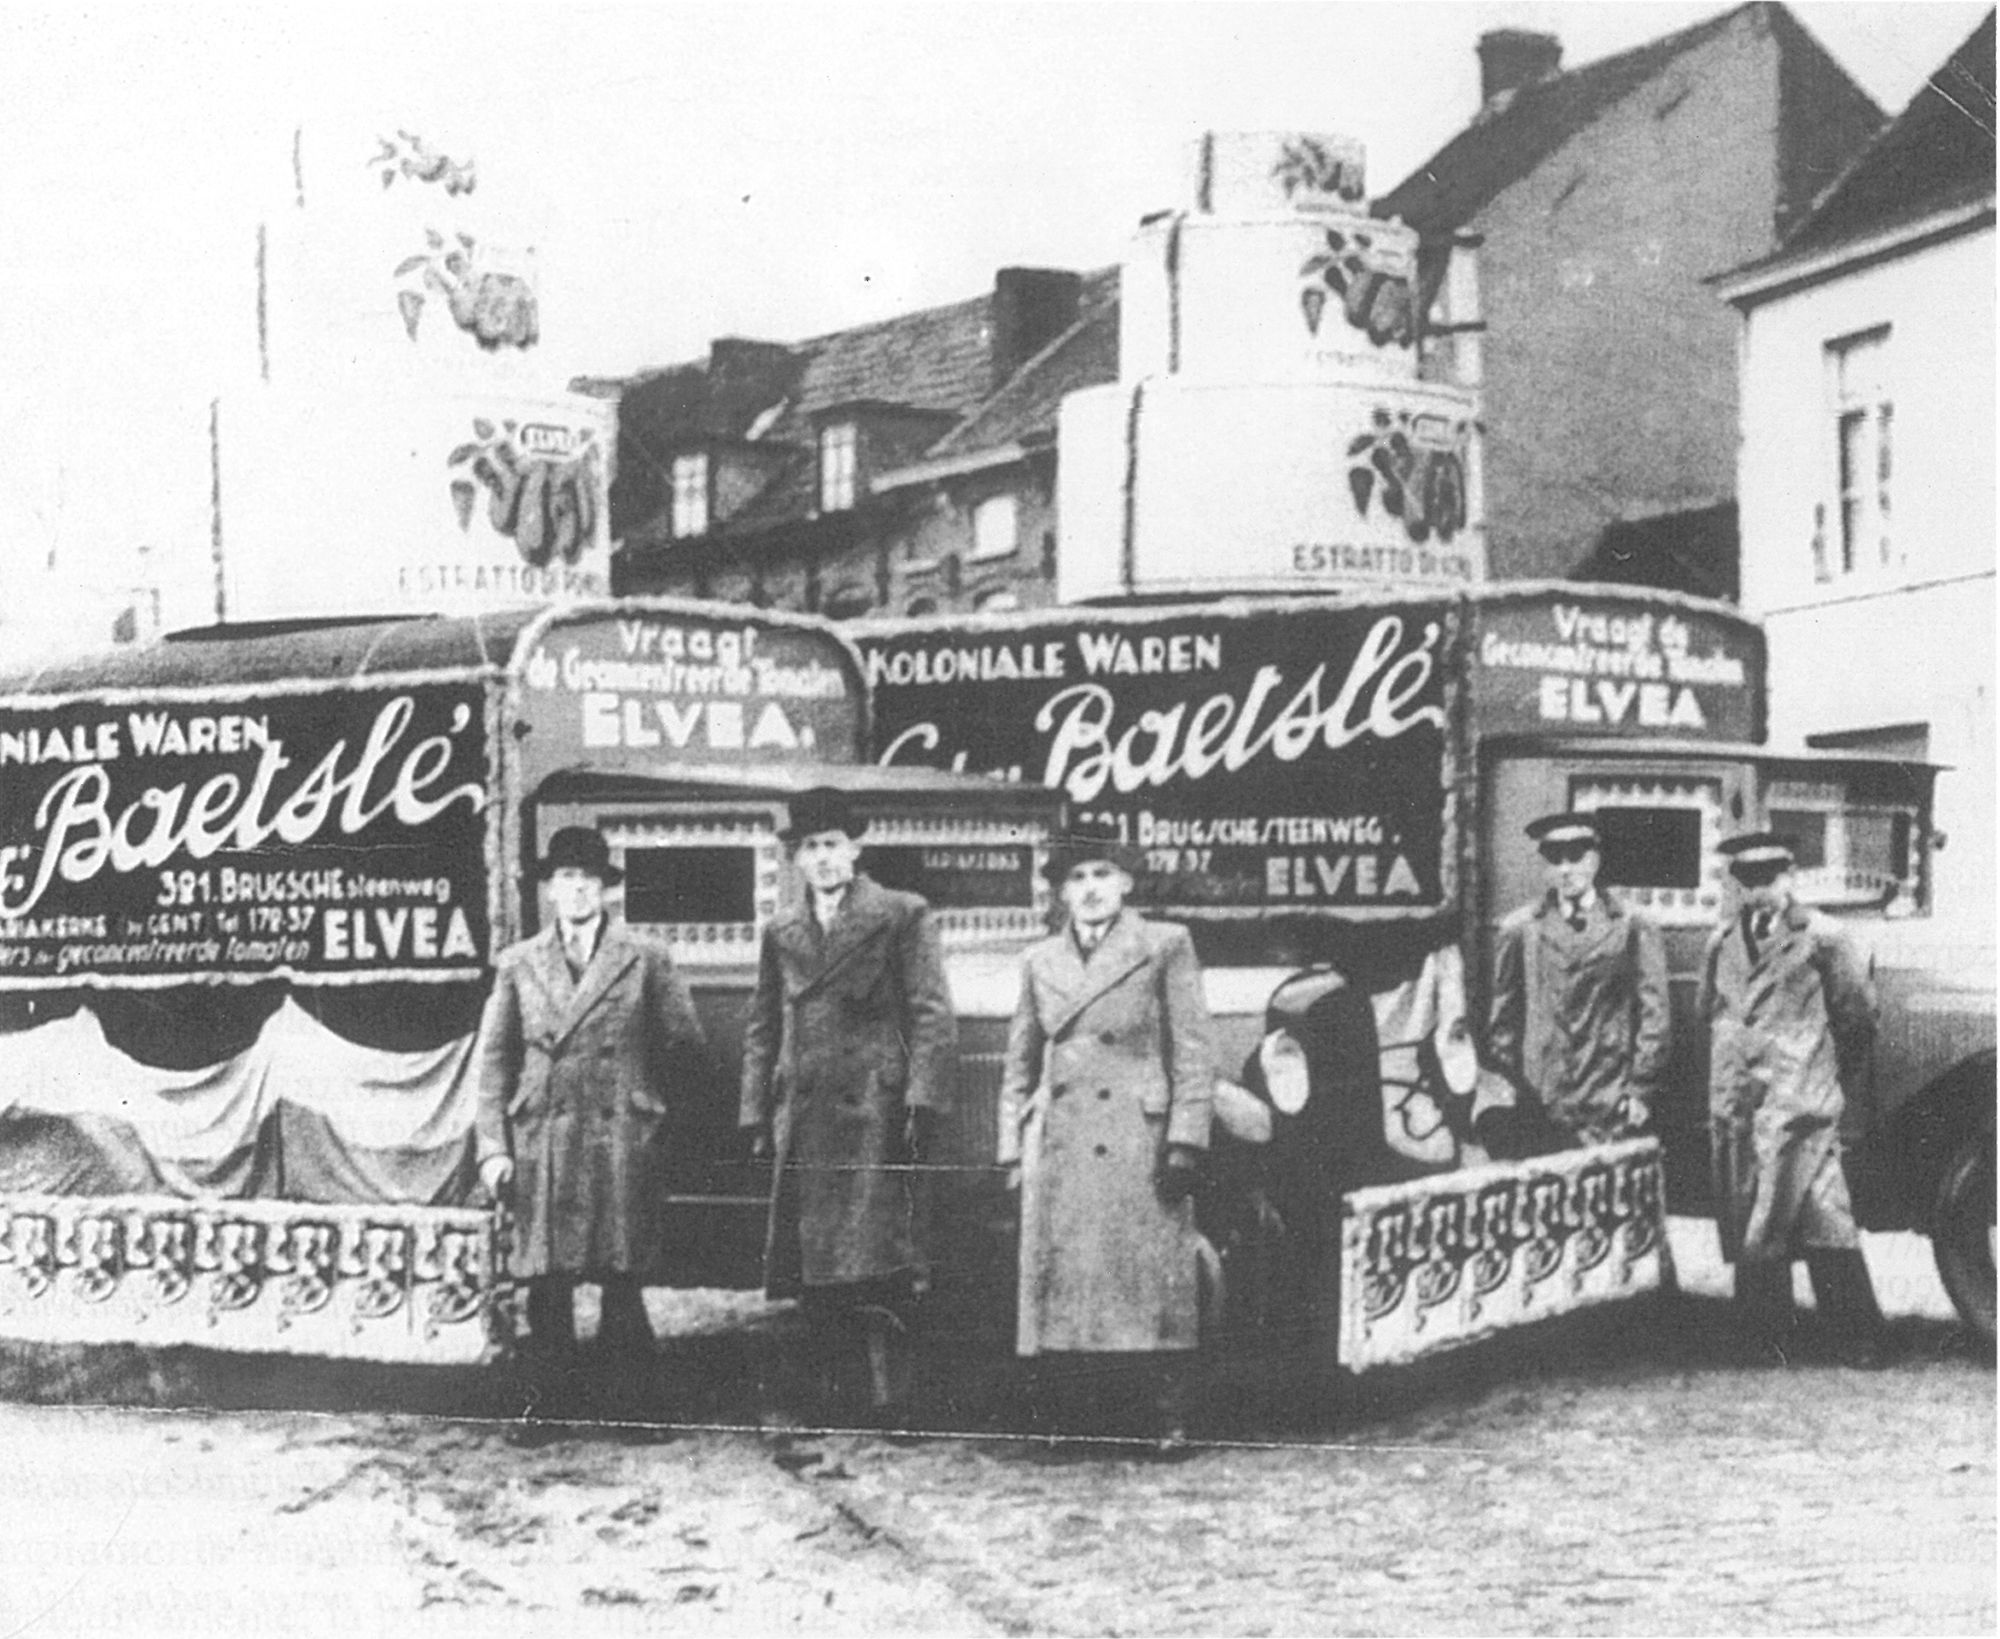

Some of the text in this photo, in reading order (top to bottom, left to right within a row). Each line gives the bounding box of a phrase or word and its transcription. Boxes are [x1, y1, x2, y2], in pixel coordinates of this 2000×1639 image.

[1293, 544, 1412, 575] ESTRATTO
[616, 618, 759, 666] Vraagt
[869, 631, 1221, 687] KOLONIALE WAREN
[1539, 674, 1706, 728] ELVEA
[128, 711, 270, 757] WAREN
[220, 867, 344, 904] BRUGSCHE
[1266, 855, 1421, 896] ELVEA
[323, 907, 477, 960] ELVEA
